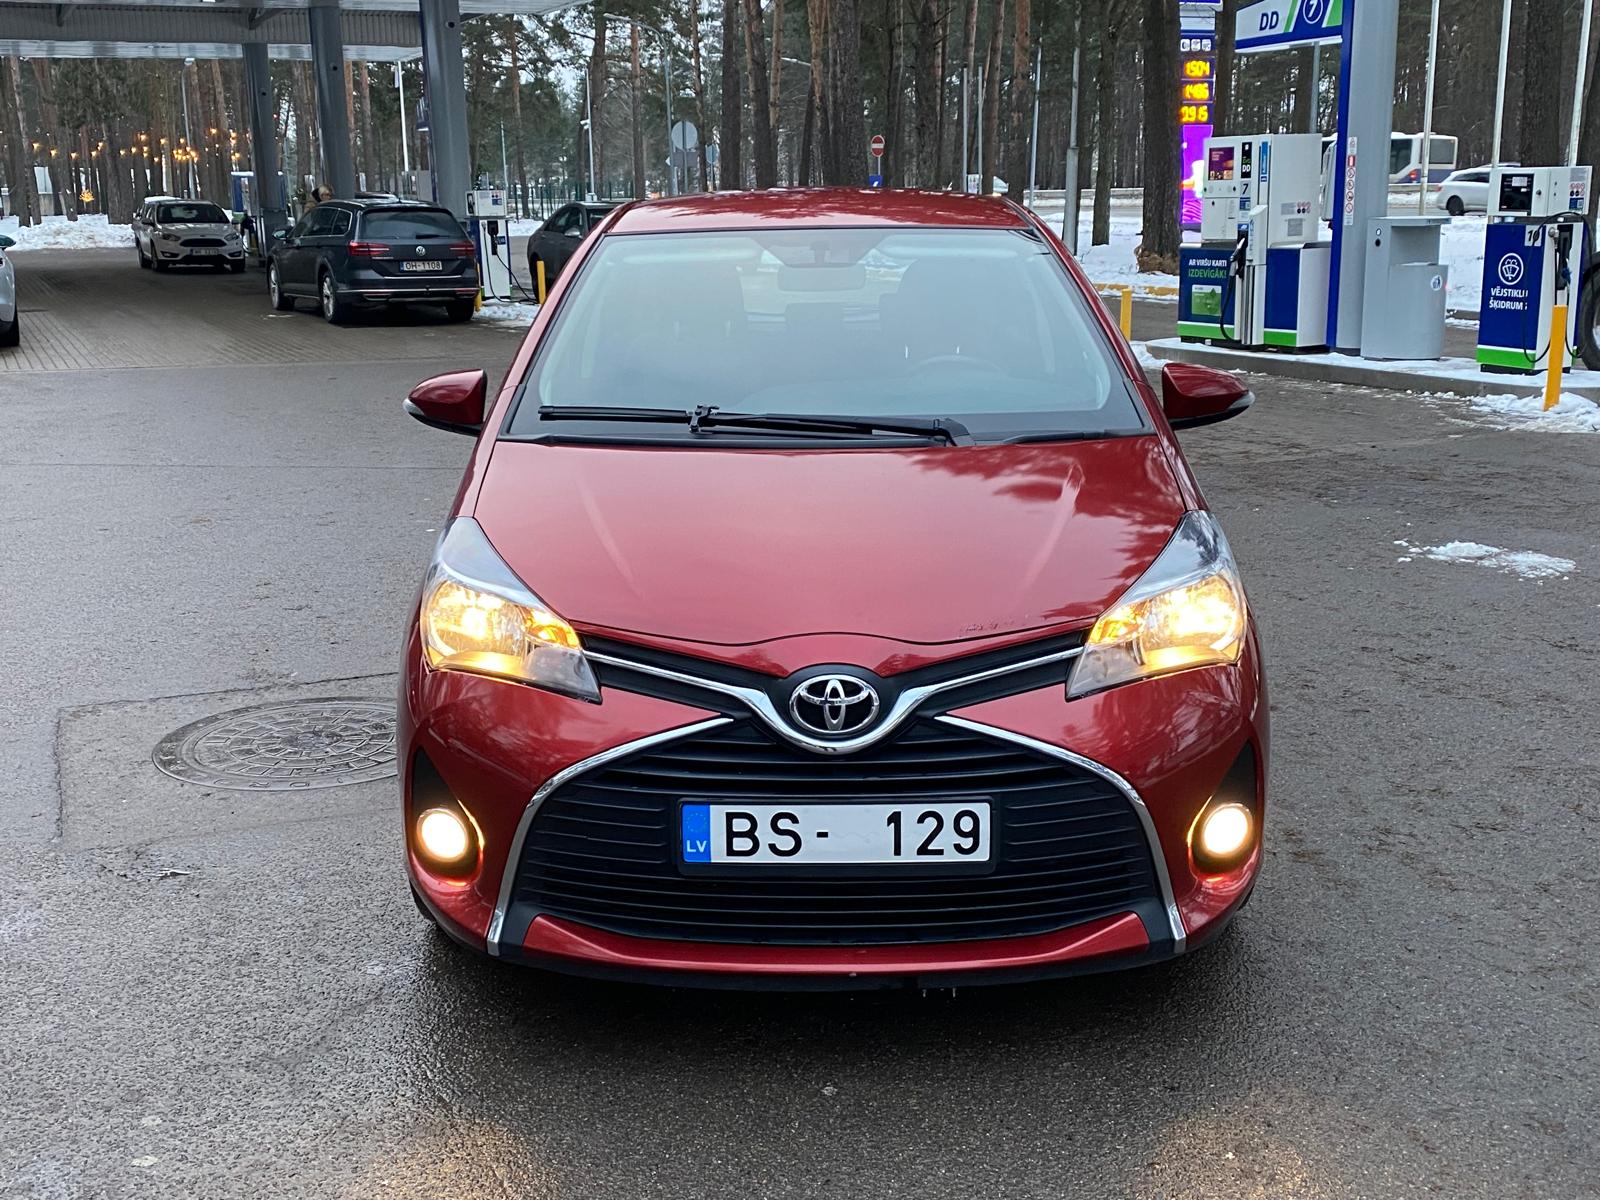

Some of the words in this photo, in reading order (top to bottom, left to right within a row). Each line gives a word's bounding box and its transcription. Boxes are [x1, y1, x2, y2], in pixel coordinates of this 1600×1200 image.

[1308, 0, 1319, 18] 7
[1259, 11, 1280, 31] DD
[1242, 164, 1251, 172] DD
[1242, 183, 1249, 195] 7
[405, 262, 441, 270] OH-1108
[1188, 258, 1197, 267] AR
[1197, 258, 1212, 267] VIRŠU
[887, 809, 980, 857] 129
[686, 840, 707, 852] LV
